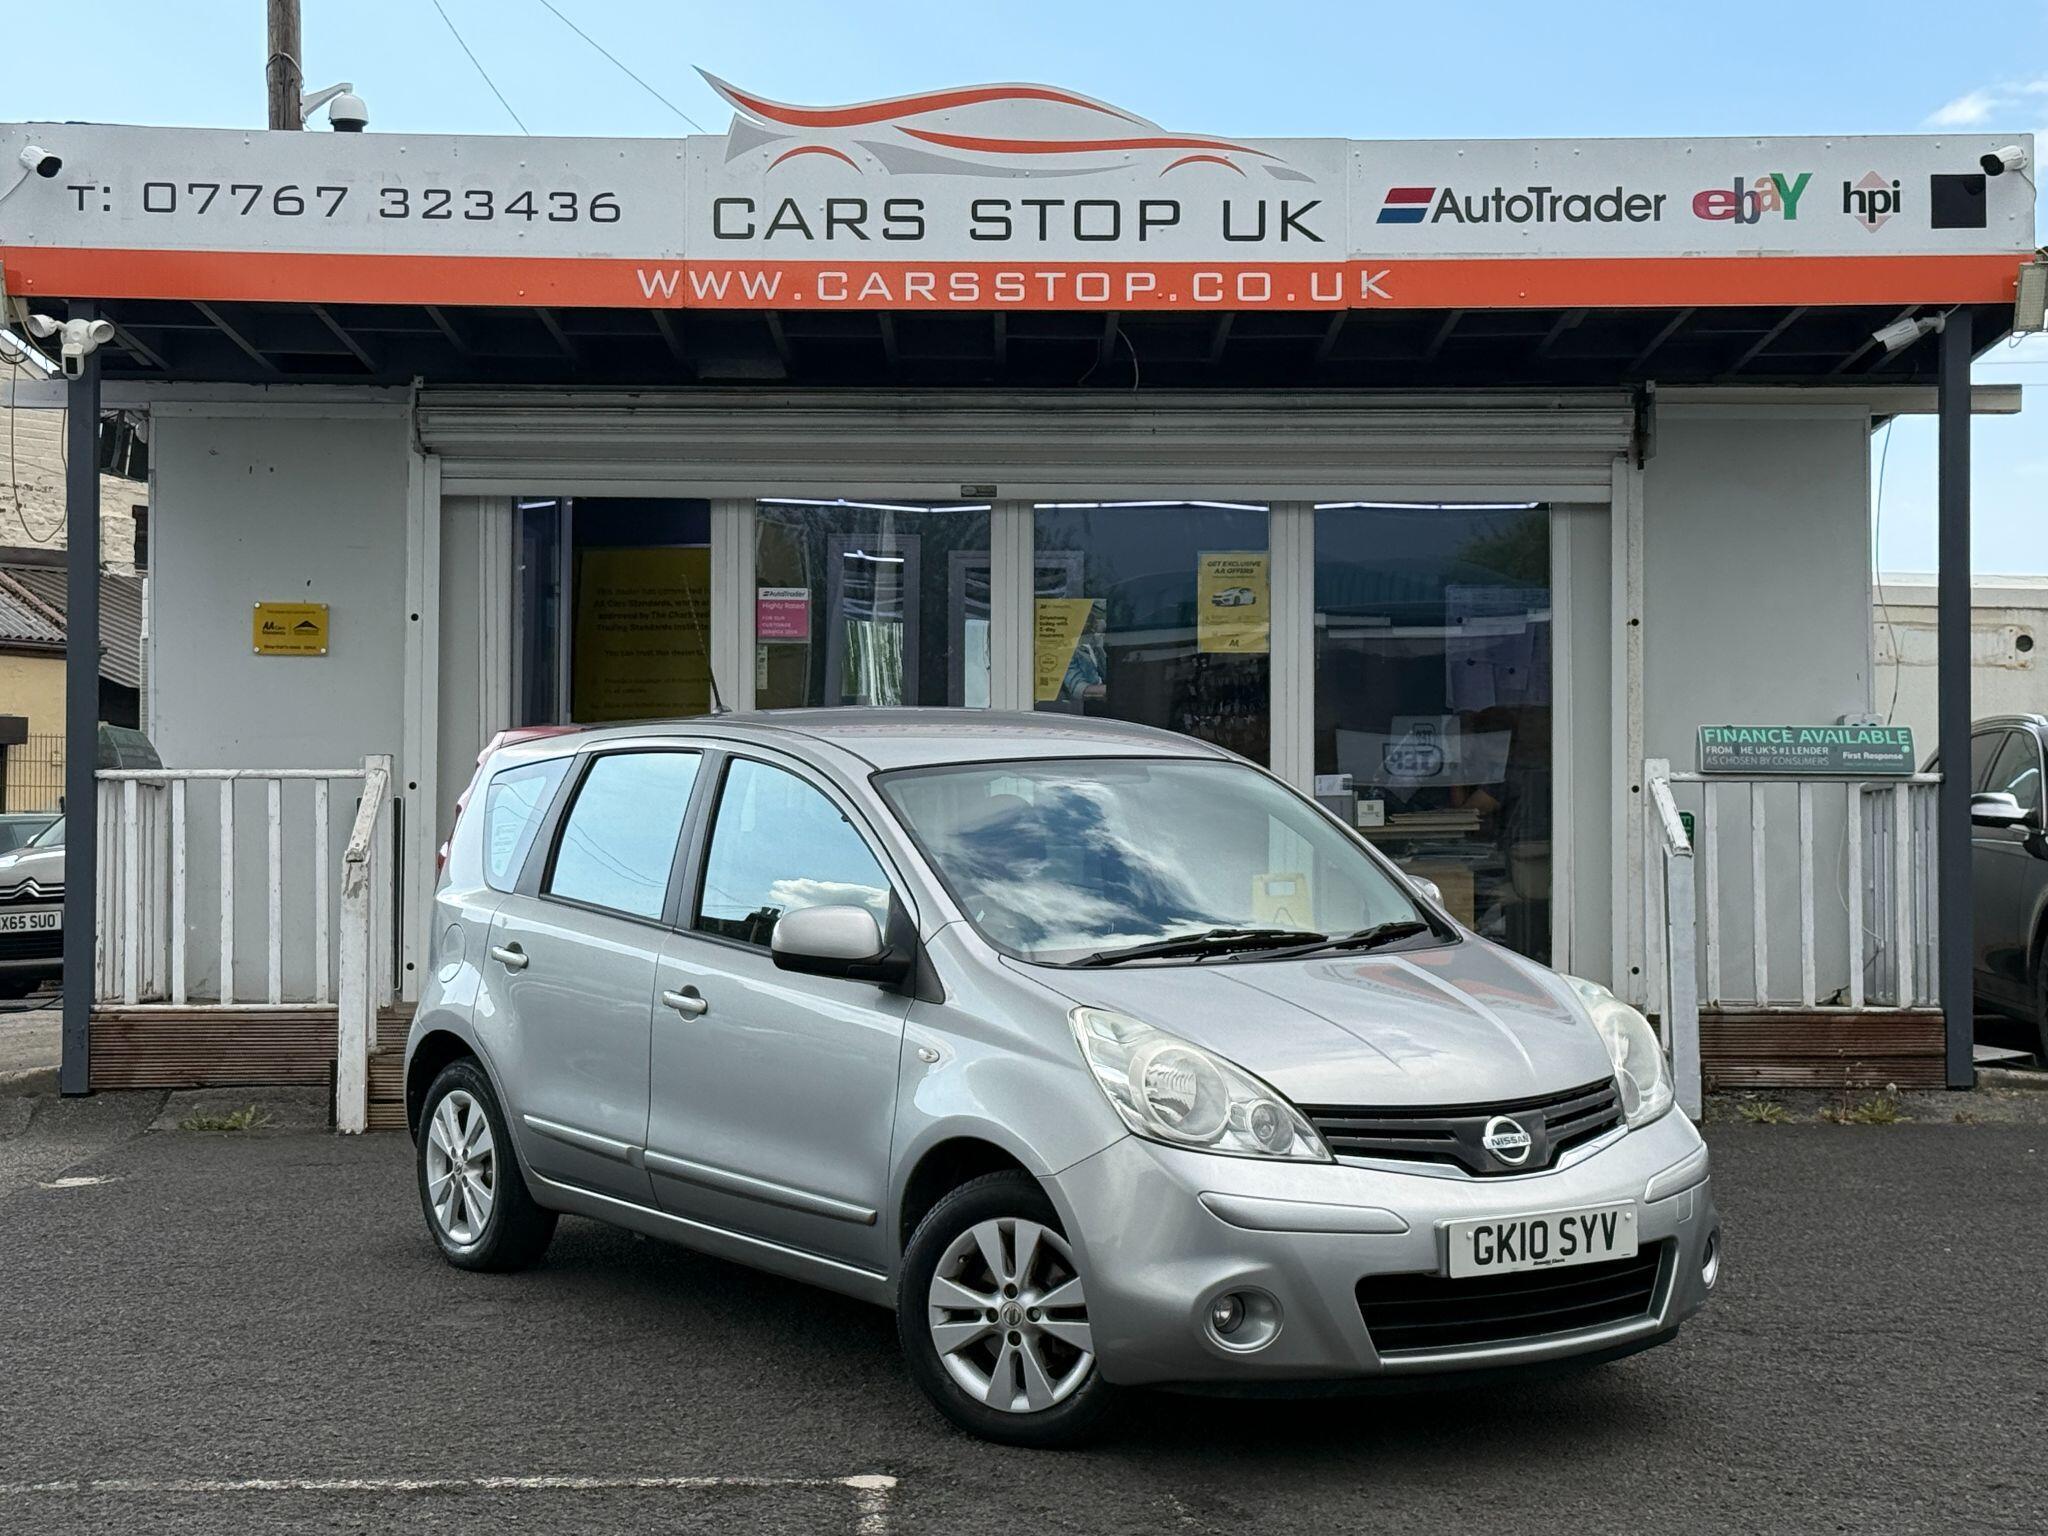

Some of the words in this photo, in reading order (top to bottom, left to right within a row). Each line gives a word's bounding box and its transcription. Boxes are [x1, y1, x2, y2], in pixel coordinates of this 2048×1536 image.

[67, 185, 111, 212] T:
[143, 182, 348, 218] 07767
[379, 187, 622, 223] 323436
[1431, 186, 1667, 224] AutoTrader
[1843, 179, 1901, 224] hpi
[713, 197, 926, 241] CARS
[969, 197, 1181, 242] STOP
[1222, 199, 1325, 243] UK
[637, 268, 1393, 303] WWW.CARSSTOP.CO.UK
[1227, 567, 1254, 575] OFFERS
[769, 590, 806, 598] AutoTrader
[1703, 729, 1794, 744] FINANCE
[1799, 730, 1910, 745] AVAILABLE
[1705, 745, 1733, 755] FROM
[1755, 745, 1777, 755] UK'S
[1792, 746, 1829, 756] LENDER
[1842, 751, 1861, 760] First
[1863, 751, 1904, 762] Response
[1720, 755, 1758, 766] CHOSEN
[1760, 756, 1770, 765] BY
[1772, 756, 1830, 767] CONSUMERS
[1490, 1134, 1530, 1146] NISSAN
[1473, 1220, 1549, 1266] GK10
[1559, 1211, 1618, 1257] SYV
